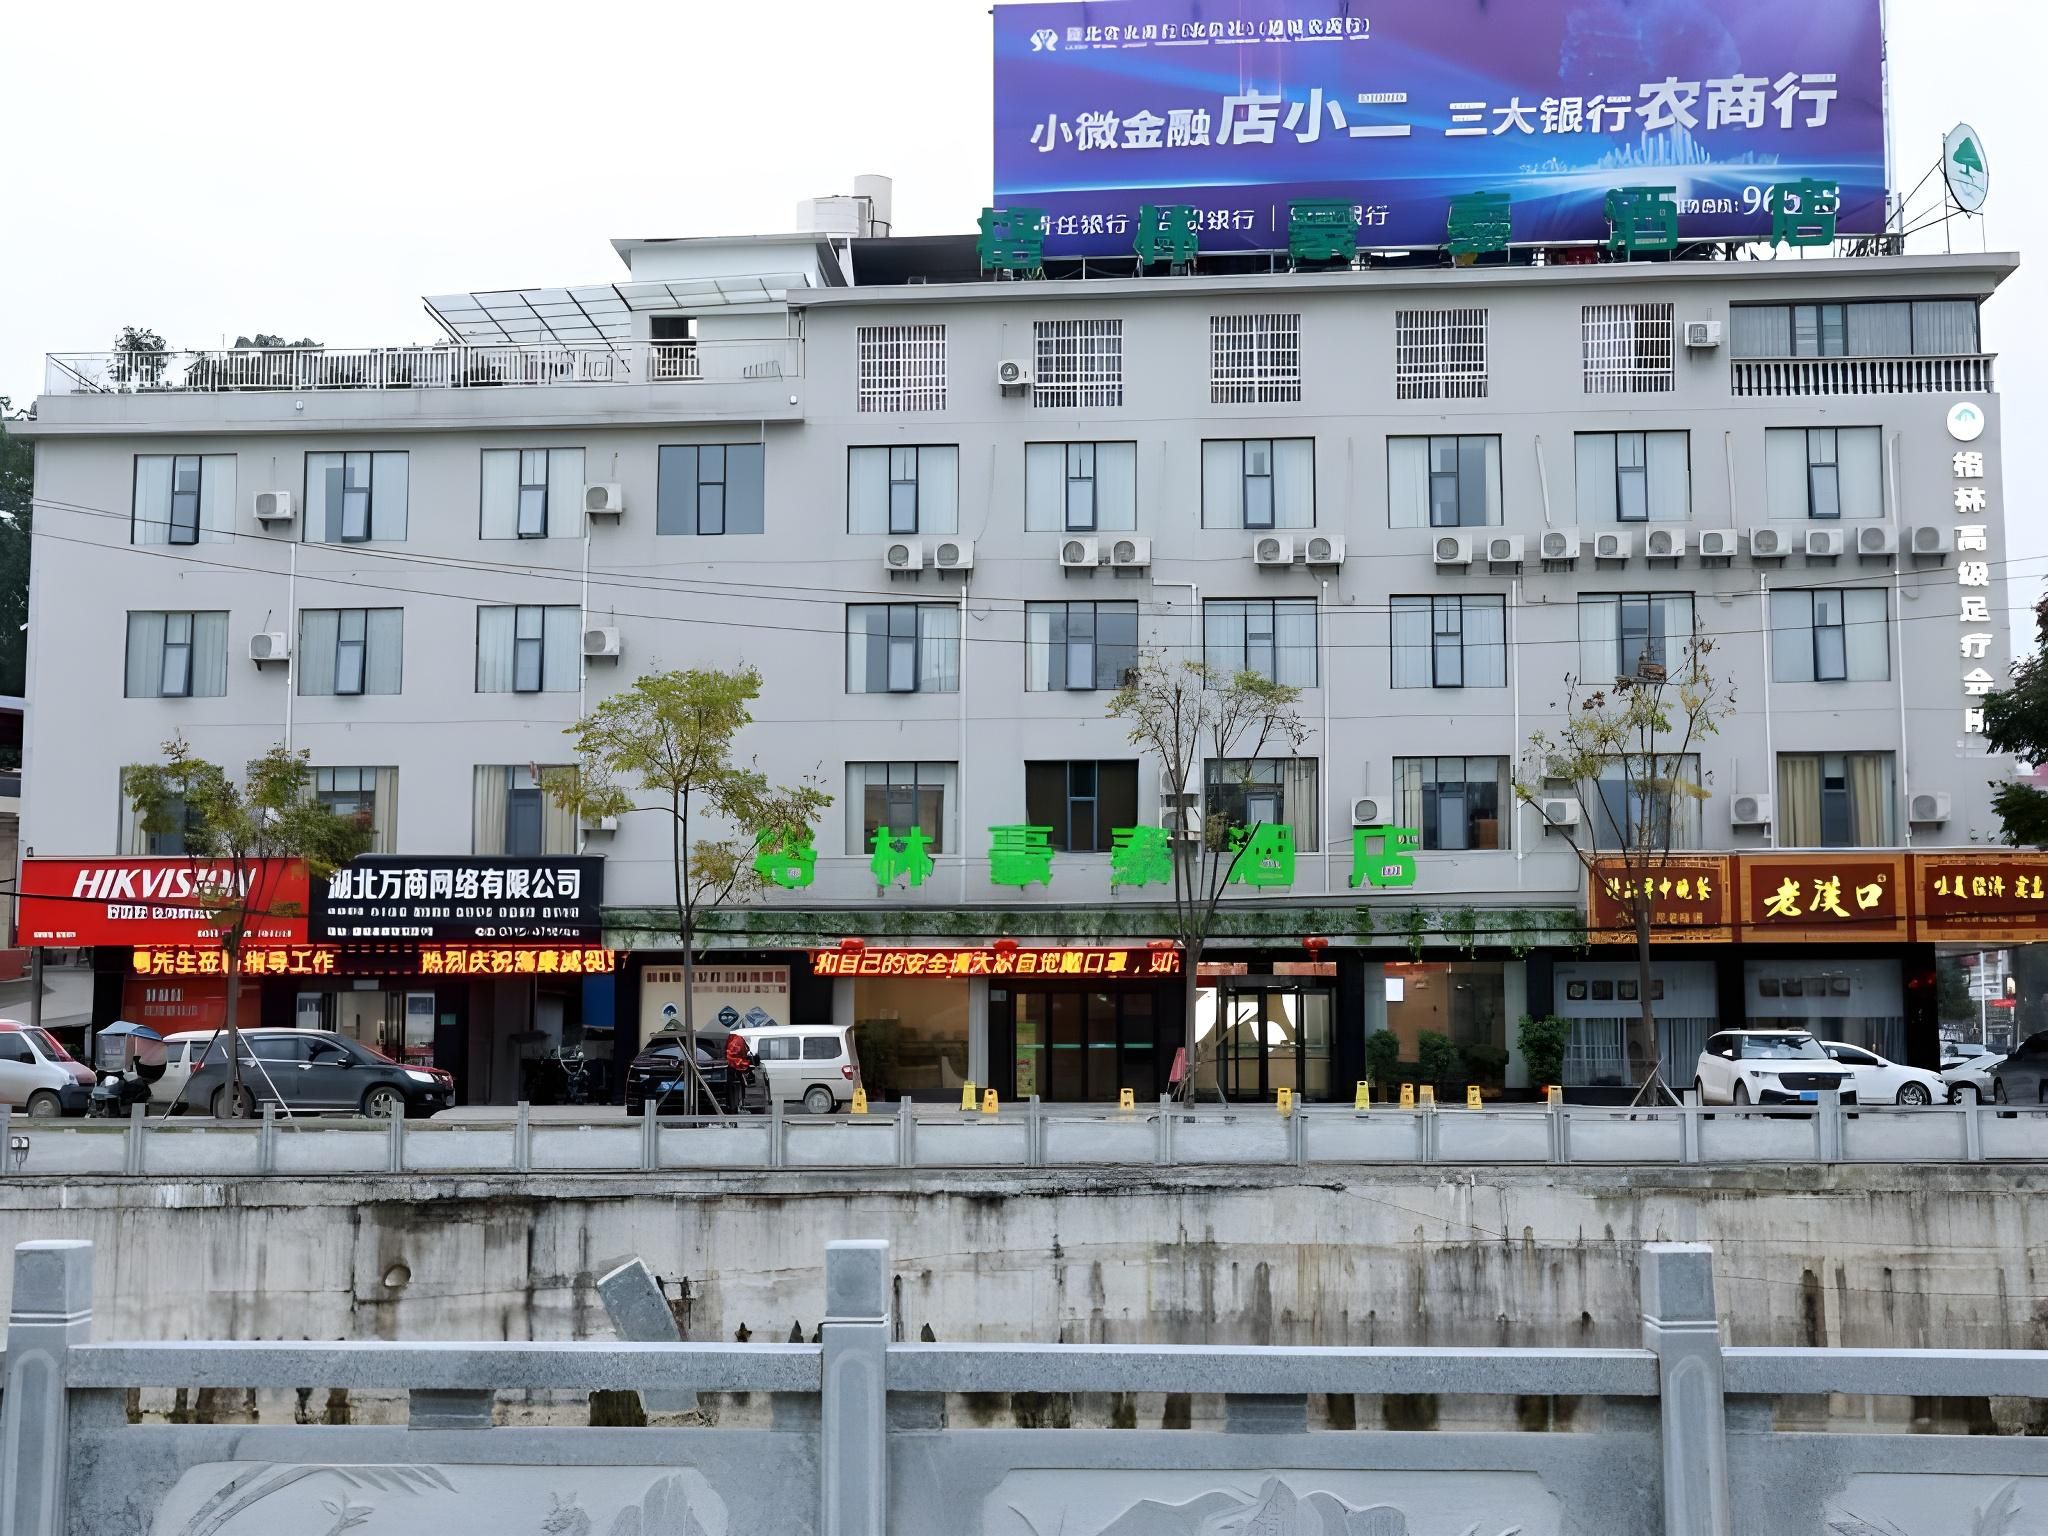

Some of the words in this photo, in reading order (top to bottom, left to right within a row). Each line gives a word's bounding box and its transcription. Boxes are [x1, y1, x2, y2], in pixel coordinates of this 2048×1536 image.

[1445, 72, 1838, 137] 三大银行农商行
[327, 868, 581, 900] 湖北万商网络有限公司
